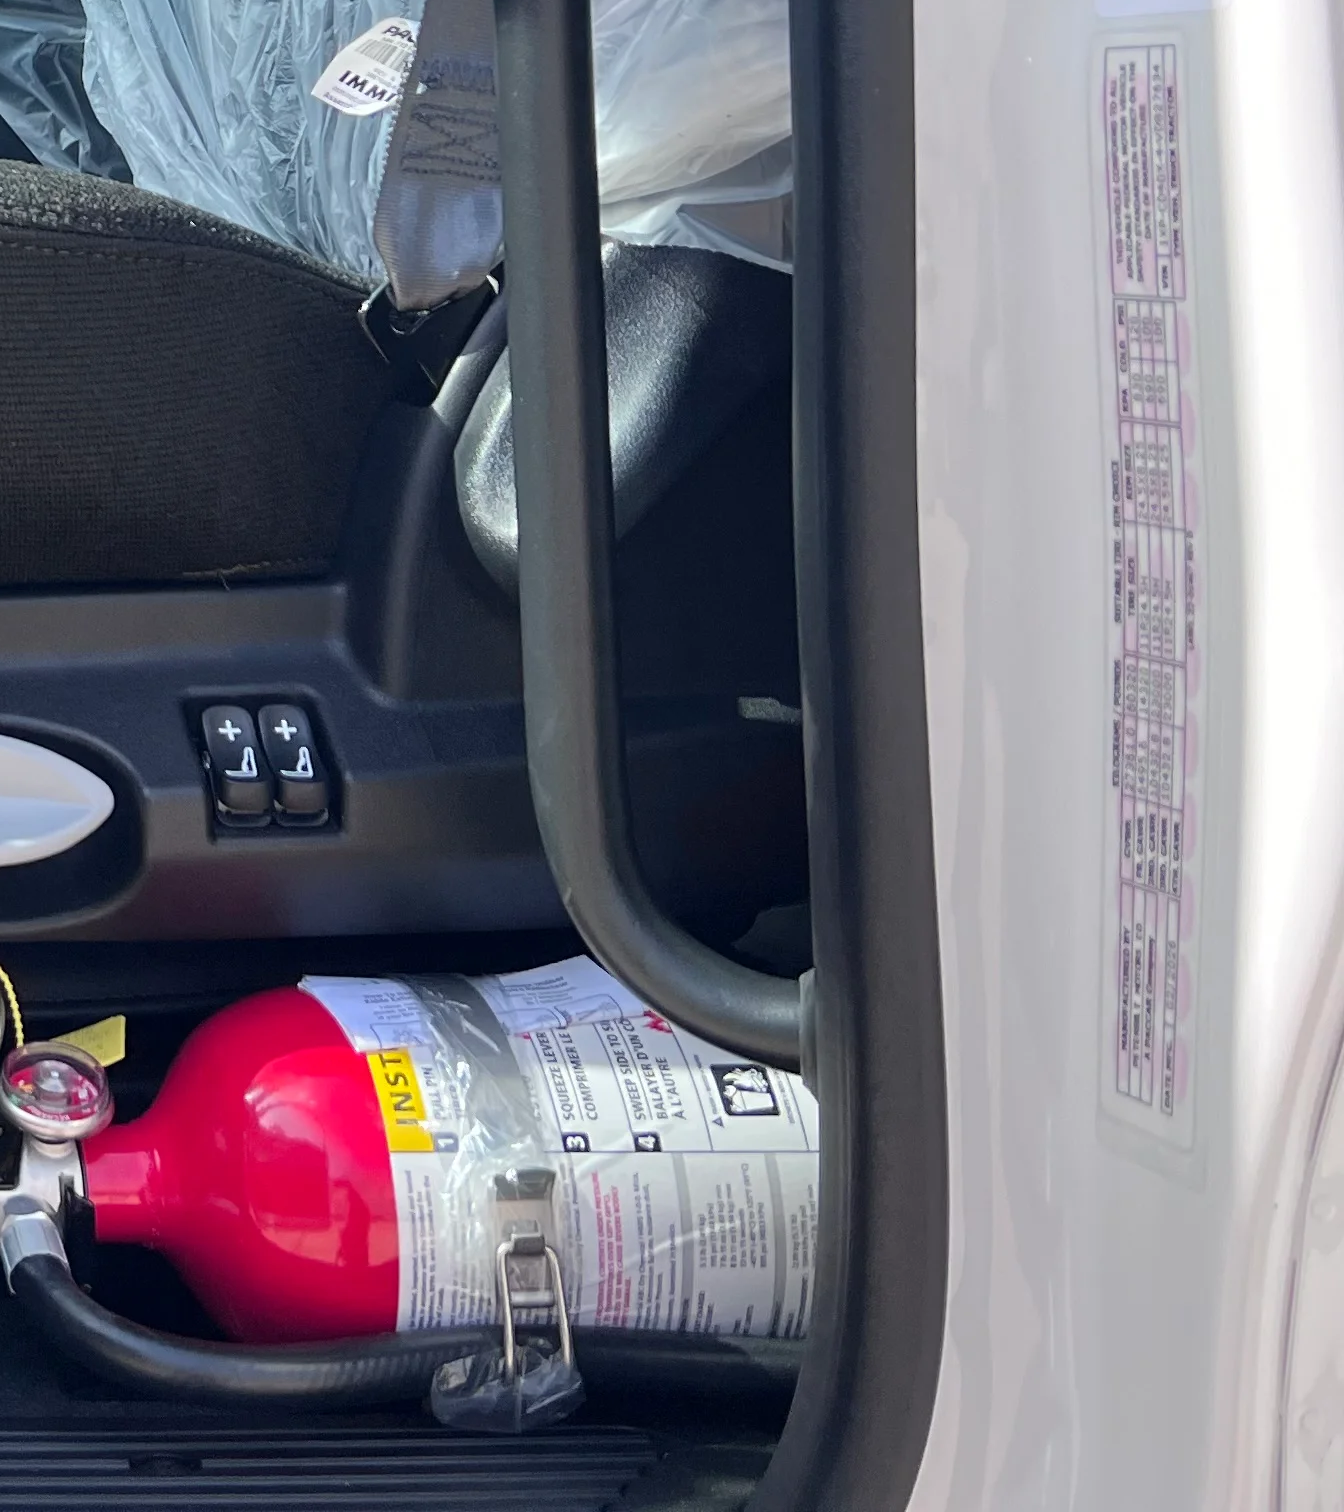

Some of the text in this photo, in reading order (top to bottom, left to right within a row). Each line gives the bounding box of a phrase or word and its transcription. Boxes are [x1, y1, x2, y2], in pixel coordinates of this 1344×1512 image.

[607, 1034, 619, 1048] TO
[616, 1049, 633, 1074] SIDE
[629, 1033, 649, 1060] D'UN
[378, 1048, 419, 1125] INST
[536, 1032, 587, 1152] 3 SQUEEZE LEVER
[566, 1047, 598, 1121] COMPRIMER
[626, 1080, 646, 1121] SWEEP
[640, 1063, 669, 1119] BALAYER
[638, 1136, 656, 1151] 4
